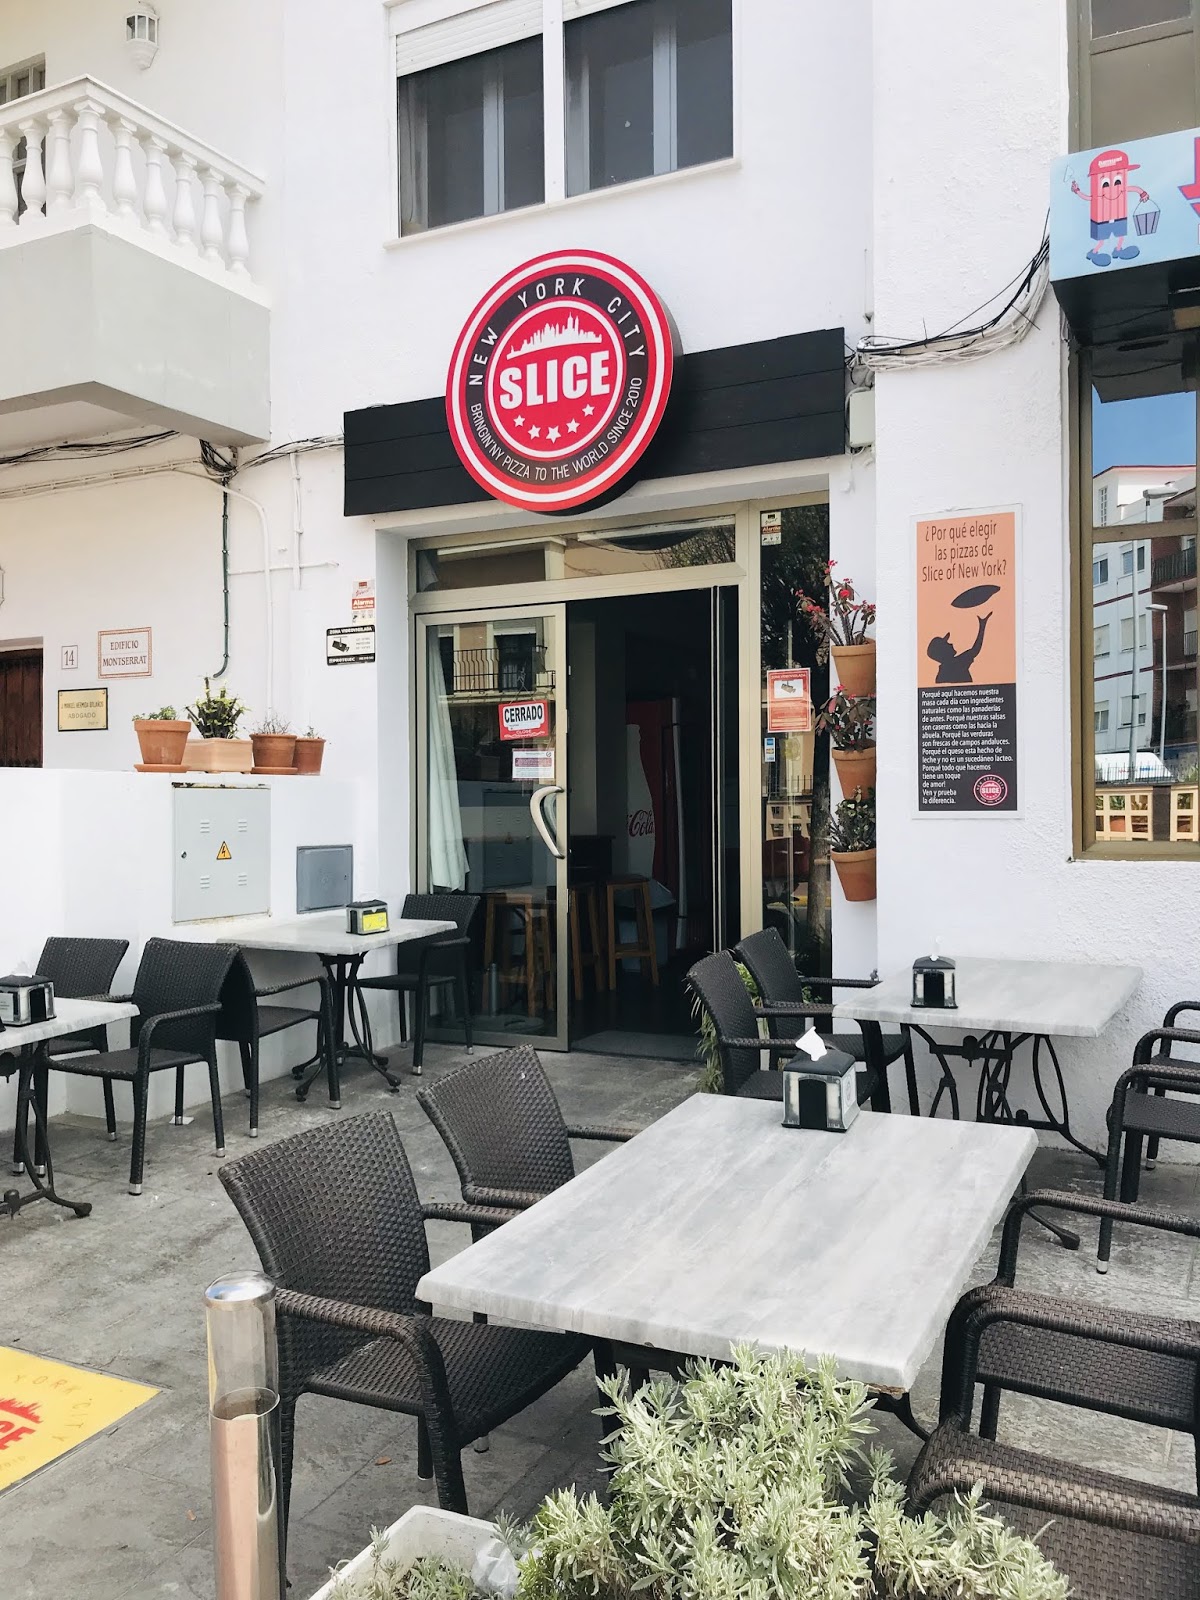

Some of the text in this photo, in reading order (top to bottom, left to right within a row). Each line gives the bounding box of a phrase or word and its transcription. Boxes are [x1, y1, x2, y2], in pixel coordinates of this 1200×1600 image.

[469, 278, 646, 386] NEW YORK CITY
[500, 350, 610, 410] SLICE
[502, 456, 530, 479] PIZZA
[535, 467, 547, 481] TO
[552, 465, 570, 480] THE
[572, 441, 609, 474] WORLD
[610, 410, 634, 444] SINCE
[626, 377, 642, 408] 2010
[925, 520, 997, 544] ¿Por qué elegir
[935, 540, 994, 563] las pizzas de
[922, 559, 1007, 582] Slice of New York?
[110, 640, 139, 650] EDIFICIO
[64, 650, 74, 666] 14
[102, 655, 147, 667] MONTSERRAT
[970, 697, 1004, 705] ingredientes
[504, 705, 542, 723] CERRADO
[938, 789, 956, 797] prueba
[14, 1374, 81, 1395] YORK
